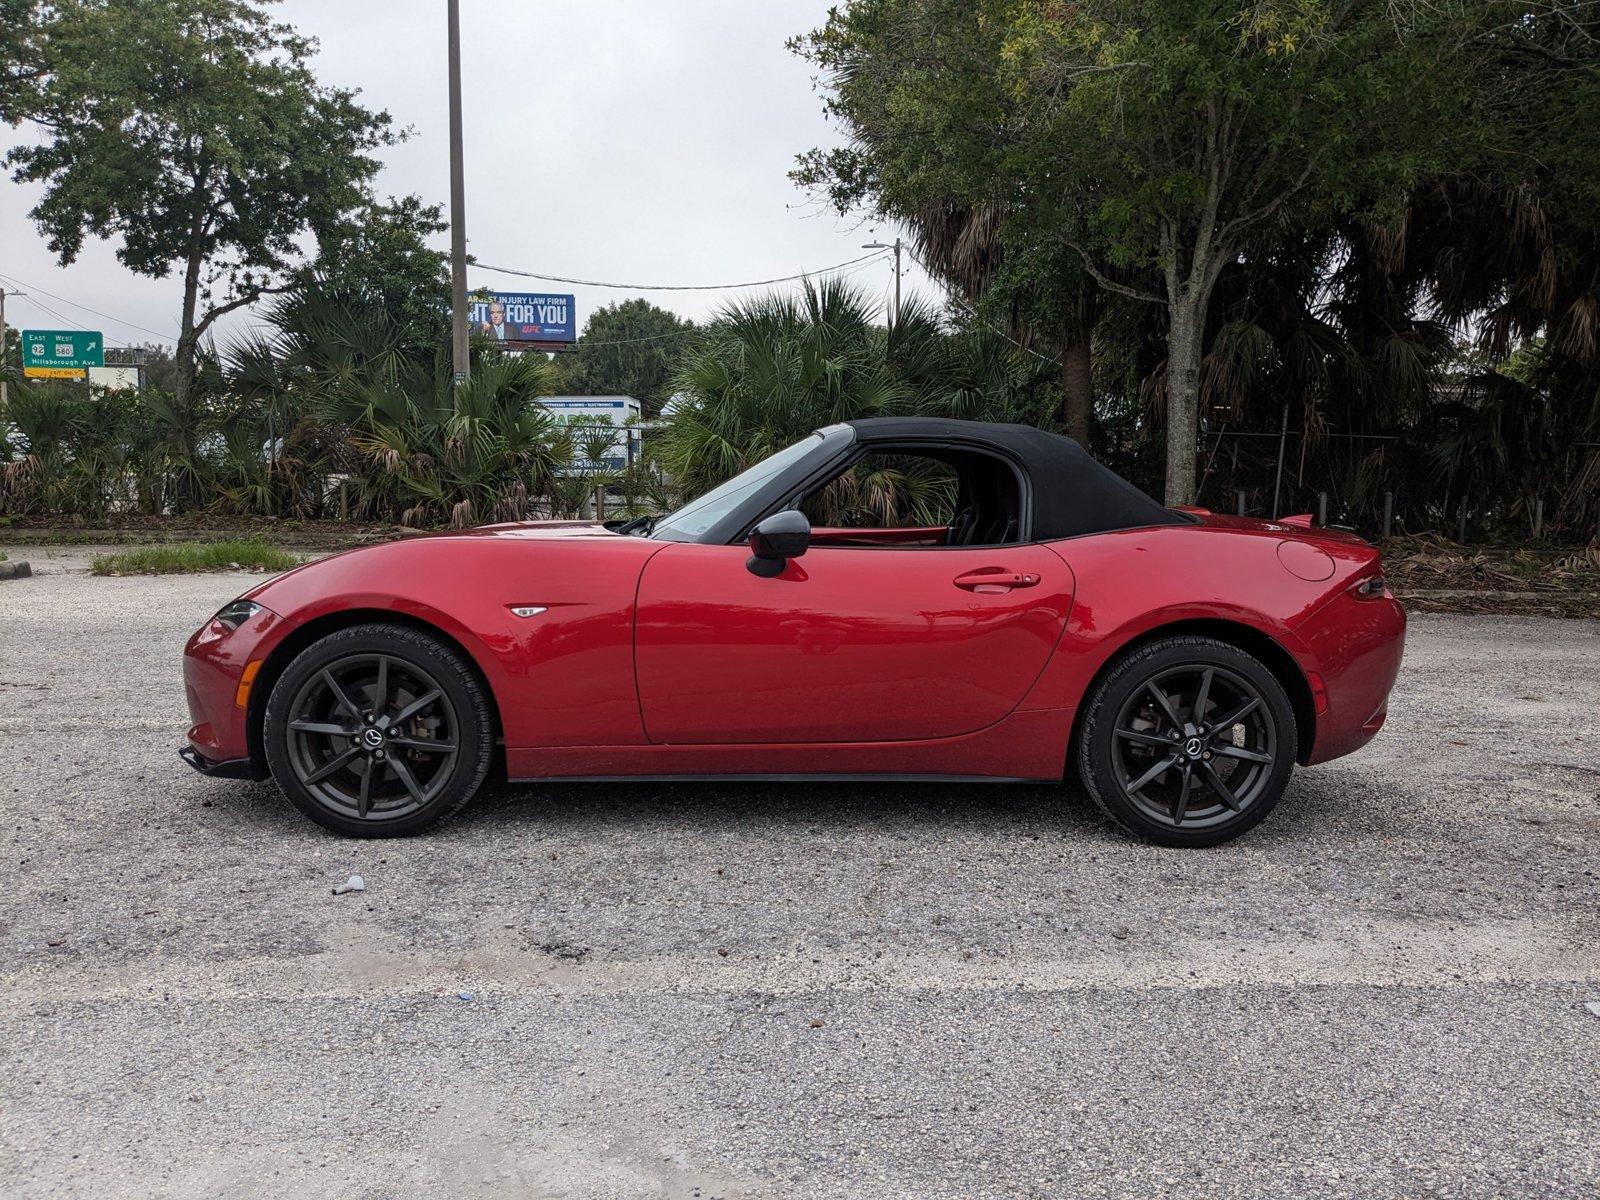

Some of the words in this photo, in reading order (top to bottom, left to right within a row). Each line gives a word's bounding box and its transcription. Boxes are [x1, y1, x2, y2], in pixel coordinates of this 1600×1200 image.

[499, 296, 527, 304] INJURY
[529, 297, 545, 305] LAW
[506, 304, 534, 323] FOR
[537, 305, 567, 324] YOU
